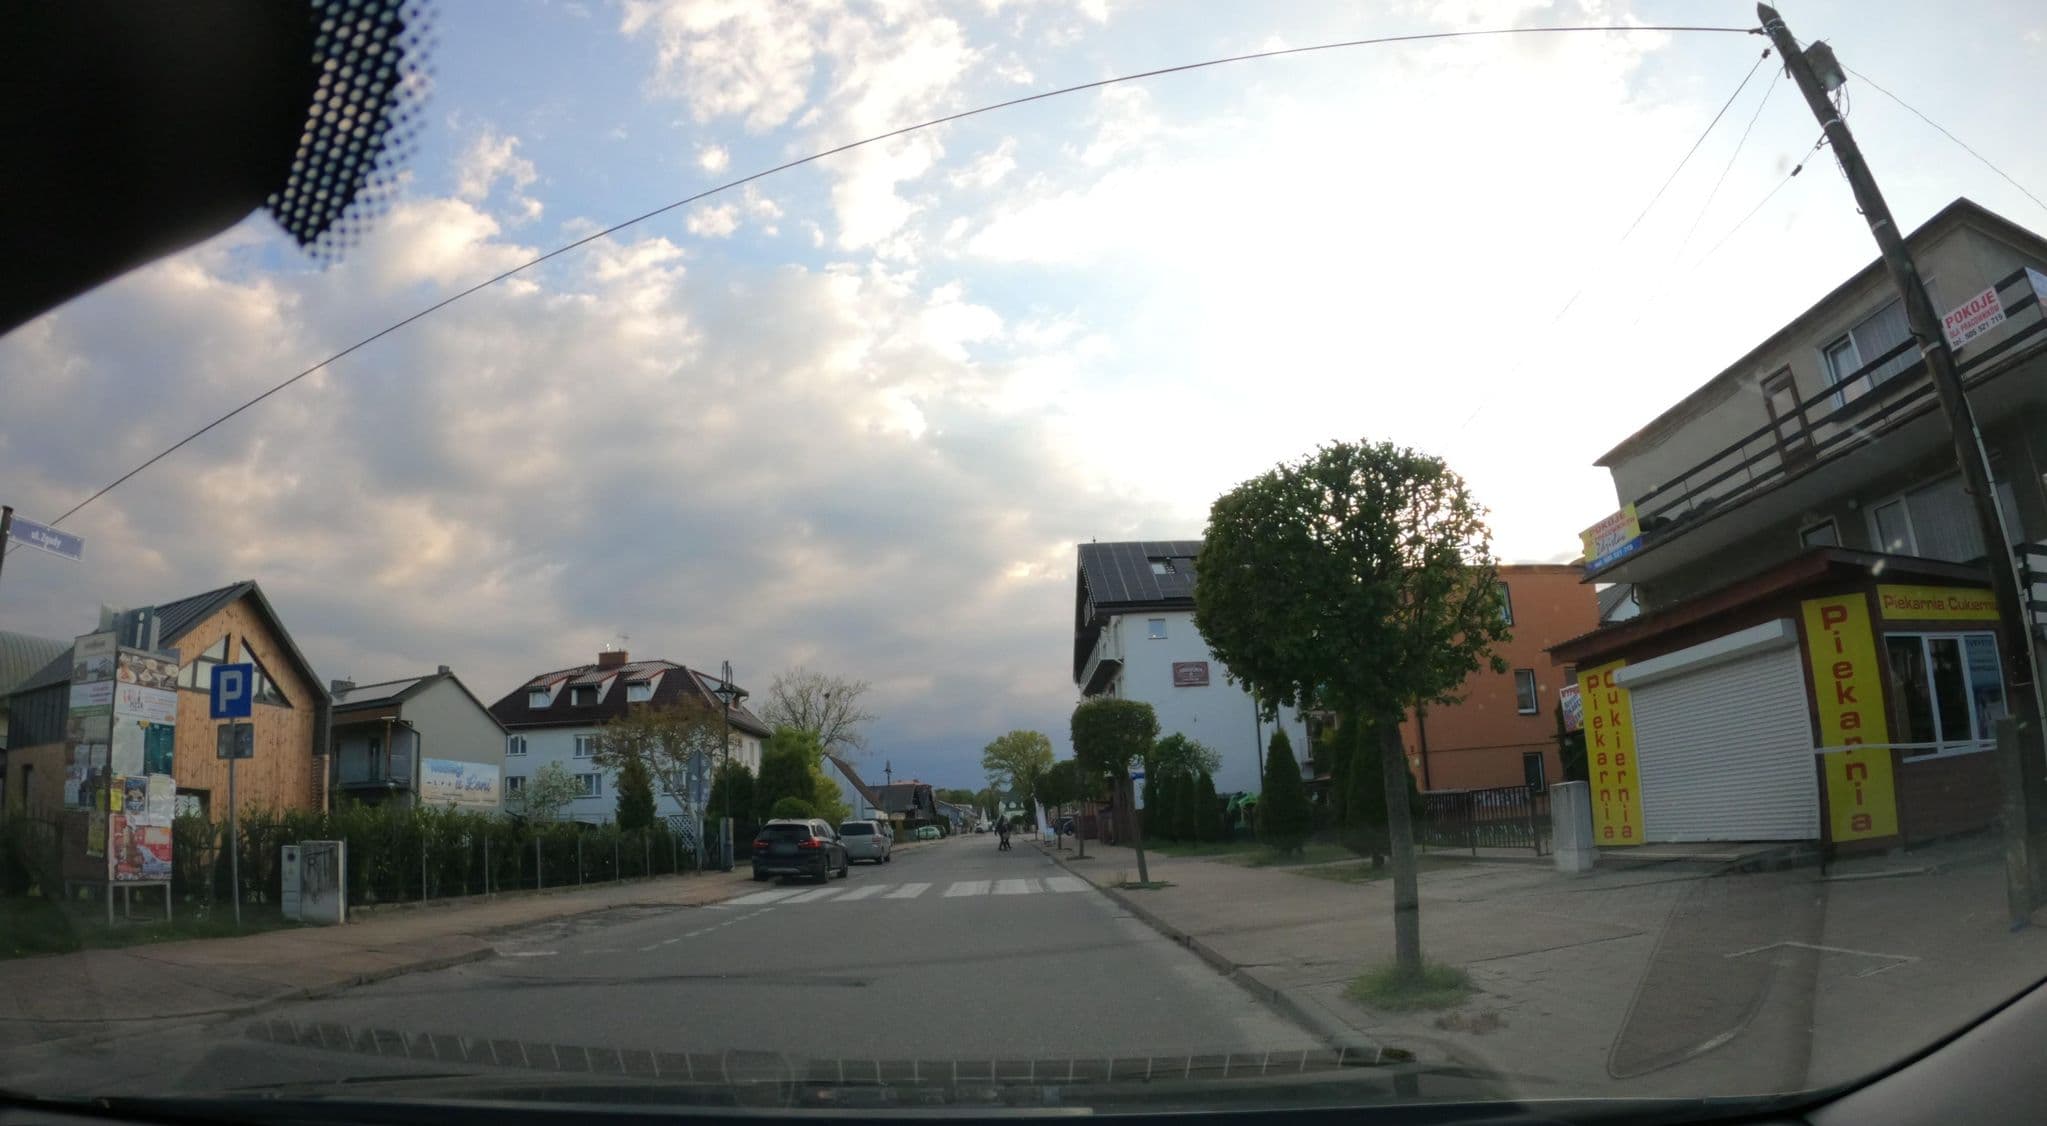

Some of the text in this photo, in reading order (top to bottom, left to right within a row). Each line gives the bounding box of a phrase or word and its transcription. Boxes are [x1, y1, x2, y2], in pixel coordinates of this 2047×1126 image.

[1945, 290, 1995, 329] POKOJE
[1977, 321, 1989, 333] 521
[1883, 594, 1945, 611] Piekarnia
[219, 670, 243, 712] P
[1821, 604, 1873, 832] Piekarnia
[1586, 674, 1615, 839] Piekarnia
[1603, 670, 1633, 838] Cukiernia
